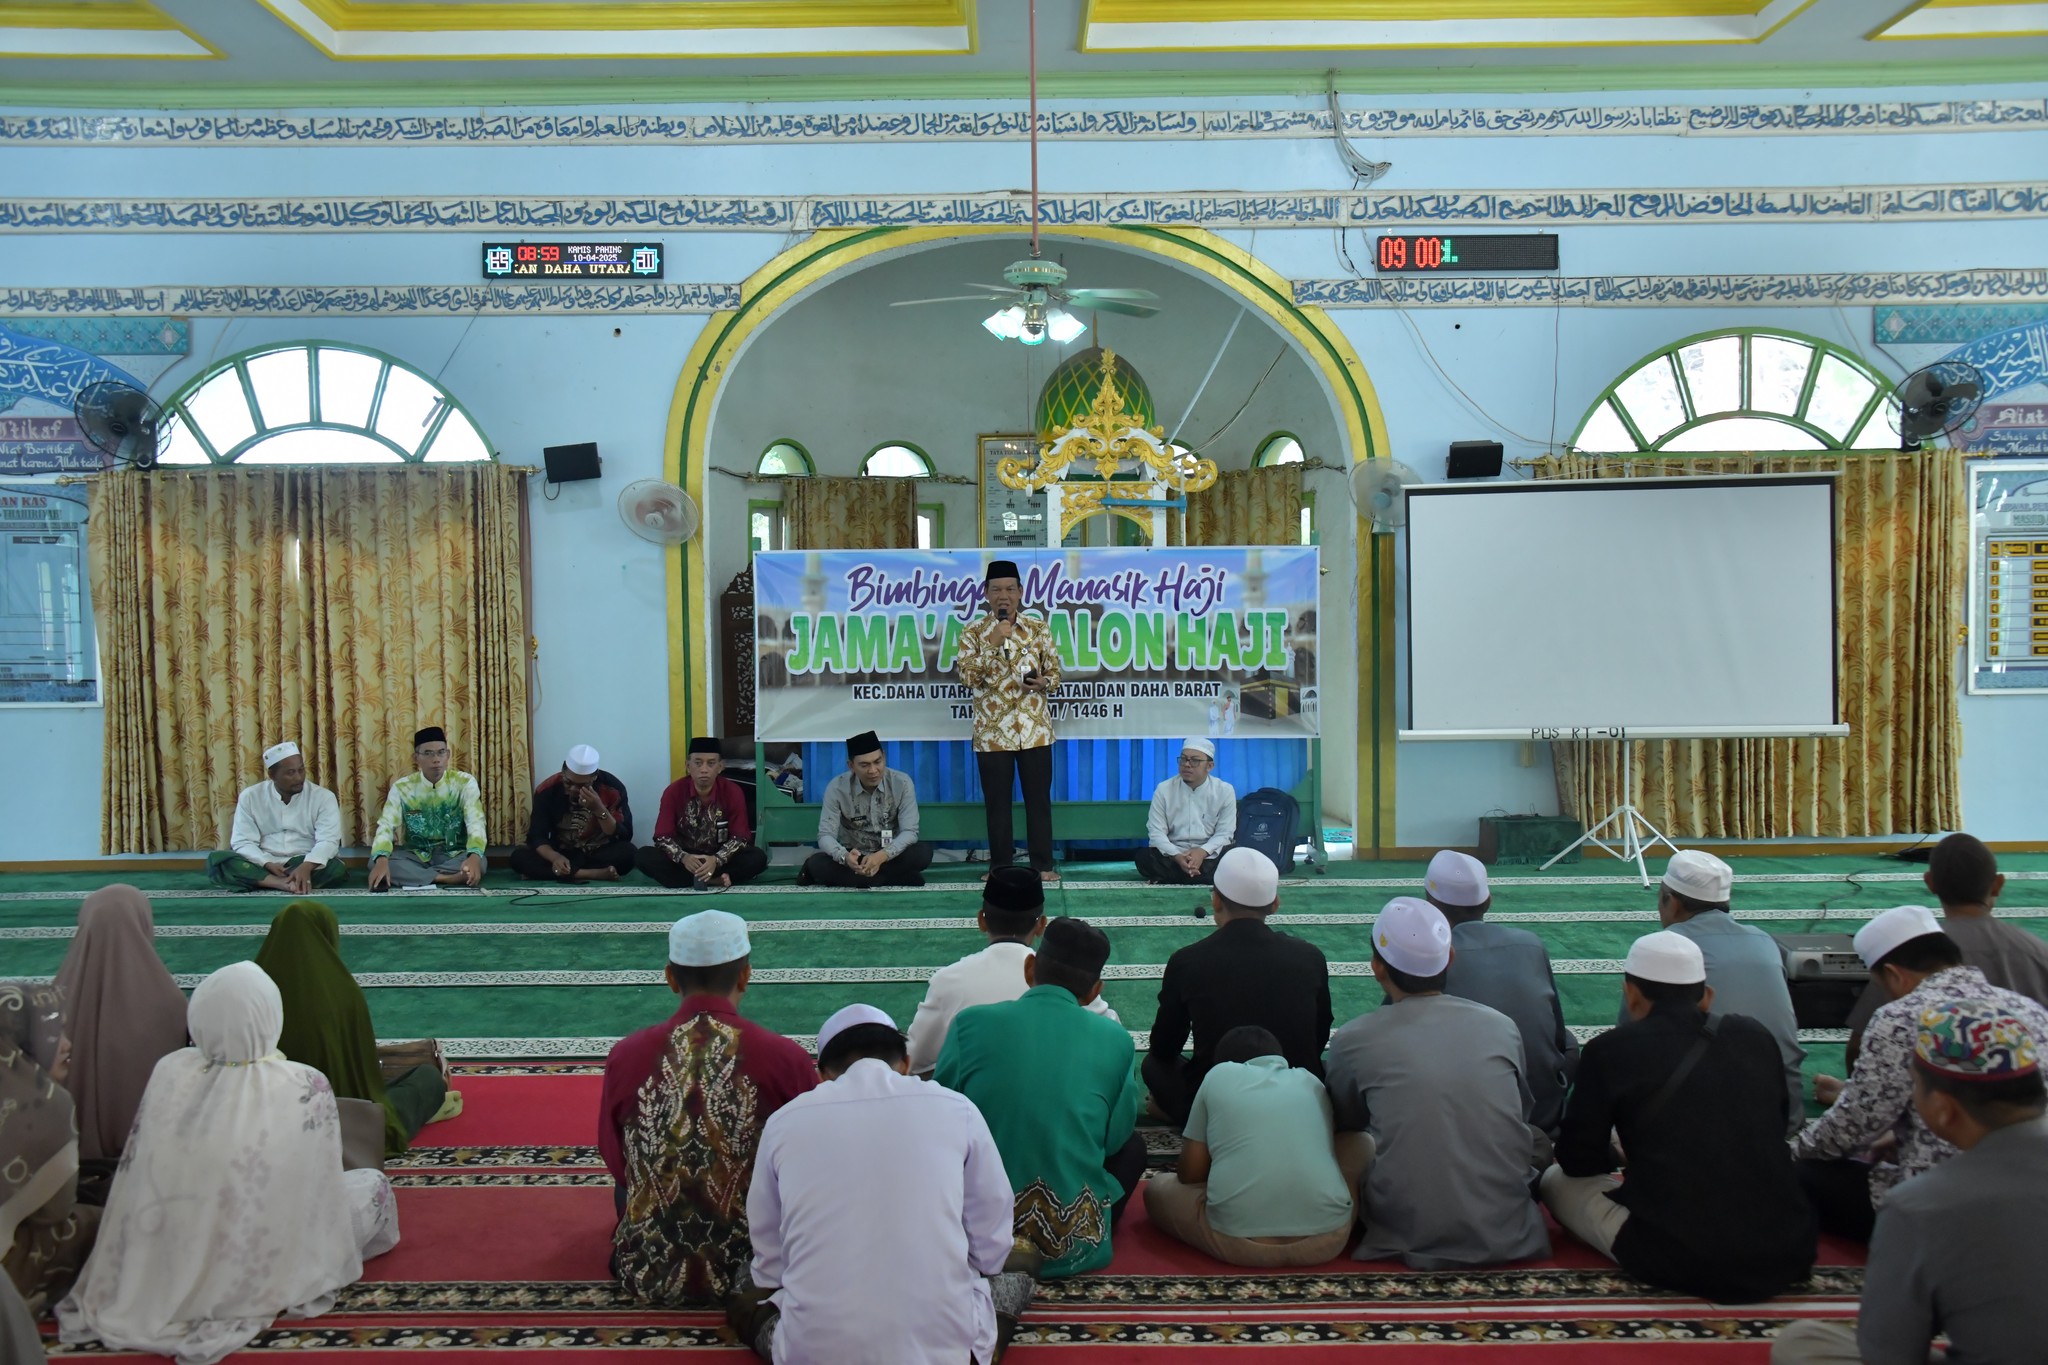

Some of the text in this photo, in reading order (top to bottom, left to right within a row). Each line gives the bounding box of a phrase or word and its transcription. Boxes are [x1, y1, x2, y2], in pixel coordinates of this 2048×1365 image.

[518, 246, 560, 261] 08:59
[567, 246, 591, 254] KAMIS
[573, 254, 618, 262] 10-04-2025
[1381, 237, 1406, 268] 09
[1415, 237, 1441, 268] 00
[545, 264, 582, 274] DAHA
[848, 562, 1225, 621] Bimbinga Manasik Haji
[788, 612, 1287, 671] JAMA'A ALON HAJI
[854, 685, 925, 699] KEC.DAHA
[1049, 684, 1091, 698] ATAN
[1097, 683, 1125, 697] DAN
[1131, 683, 1169, 697] DAHA
[1175, 683, 1220, 697] BARAT
[951, 705, 973, 719] TAH
[1073, 704, 1107, 718] 1446
[1114, 704, 1122, 717] H
[1531, 727, 1560, 739] POS
